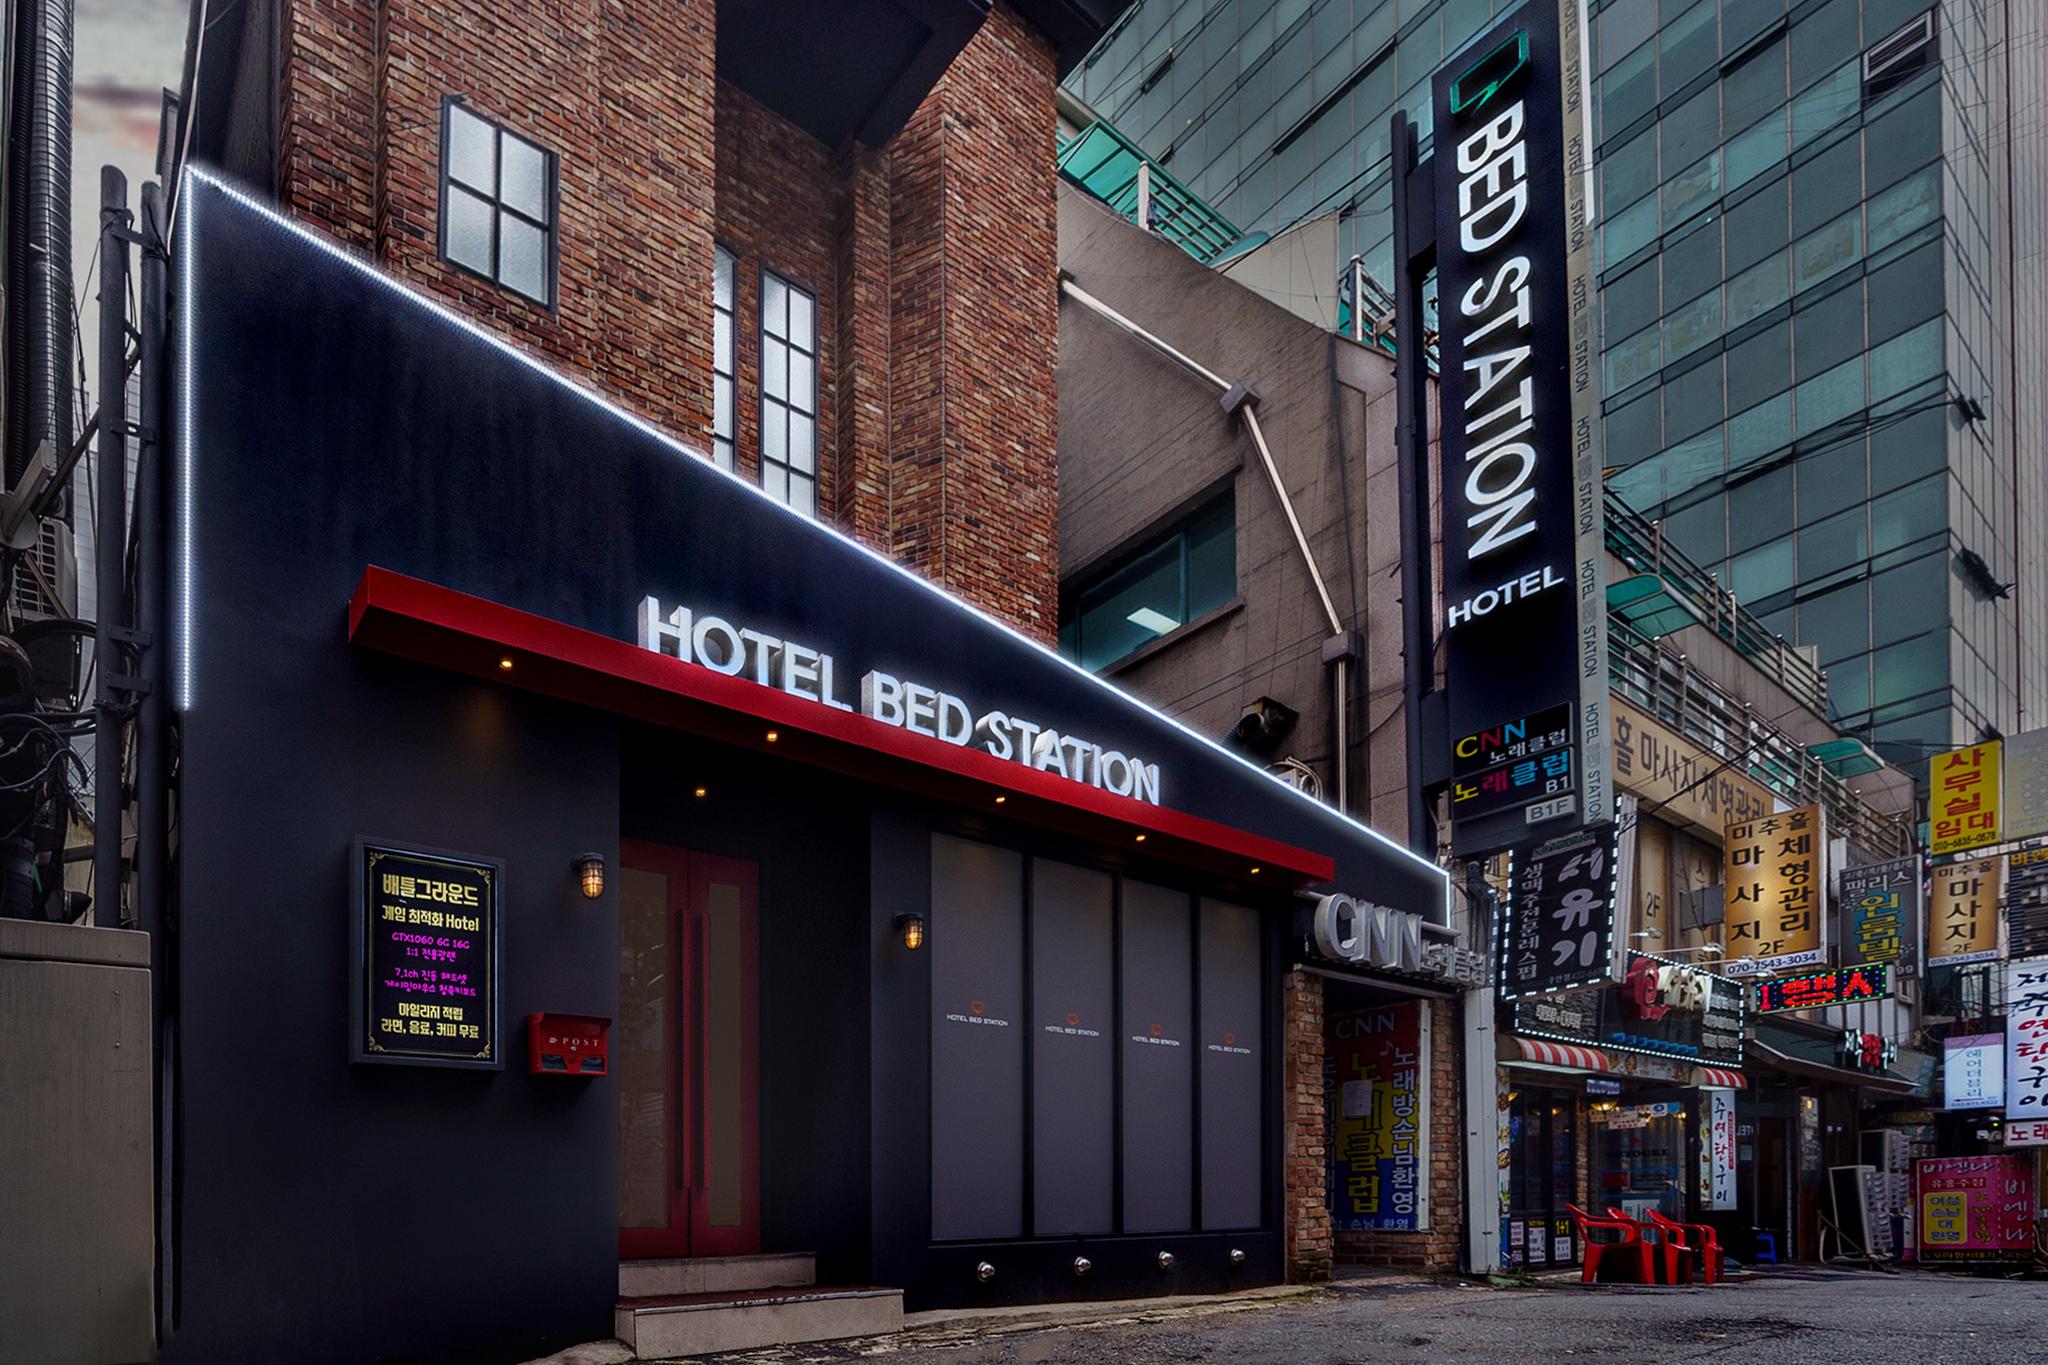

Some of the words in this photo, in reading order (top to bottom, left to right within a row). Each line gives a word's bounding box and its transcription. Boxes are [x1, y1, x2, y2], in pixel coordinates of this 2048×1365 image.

[1567, 60, 1581, 114] STATION
[1568, 133, 1582, 176] HOTEL
[1456, 99, 1528, 253] BED
[1570, 199, 1585, 255] STATION
[1572, 274, 1586, 318] HOTEL
[1574, 340, 1589, 394] STATION
[1460, 255, 1538, 560] STATION
[1576, 415, 1591, 458] HOTEL
[1579, 481, 1594, 536] STATION
[1447, 565, 1566, 629] HOTEL
[1581, 558, 1595, 600] HOTEL
[1583, 624, 1598, 678] STATION
[637, 595, 853, 712] HOTEL
[861, 669, 973, 747] BED
[973, 709, 1160, 806] STATION
[1456, 718, 1526, 759] CNN
[1585, 702, 1600, 744] HOTEL
[1488, 727, 1567, 766] 노래클럽
[1640, 731, 1697, 803] 마사지
[1453, 750, 1569, 803] 노래클럽
[1545, 775, 1569, 794] B1
[1587, 769, 1602, 823] STATION
[1943, 748, 1986, 817] 사무실
[1530, 800, 1568, 820] B1F
[1732, 811, 1810, 841] 미추홀
[1935, 810, 1994, 839] 임대
[382, 873, 479, 907] 배틀그라운드
[1730, 844, 1765, 942] 마사지
[1776, 833, 1815, 933] 체형관리
[1844, 871, 1914, 898] 팰리스
[381, 904, 407, 922] 게임
[408, 908, 444, 928] 최적화
[445, 912, 480, 932] Hotel
[1552, 847, 1605, 967] 서유기
[1856, 891, 1905, 962] 원룸텔
[1944, 878, 1985, 941] 마사지
[391, 931, 434, 946] GTX1060
[436, 937, 450, 947] 6G
[452, 939, 470, 950] 16G
[1314, 893, 1424, 973] CNN
[1757, 939, 1785, 957] 2F
[1953, 942, 1973, 954] 2F
[394, 967, 420, 979] 7.1ch
[1726, 951, 1817, 975] 070-7543-3034
[381, 1017, 407, 1034] 라면,
[408, 1020, 434, 1036] 음료,
[436, 1022, 457, 1037] 커피
[458, 1024, 480, 1039] 무료
[398, 1002, 441, 1020] 마일리지
[442, 1005, 464, 1021] 적립
[946, 1013, 969, 1023] HOTEL
[983, 1017, 1009, 1027] STATION
[1045, 1025, 1064, 1034] HOTEL
[1077, 1029, 1100, 1037] STATION
[1336, 1012, 1396, 1039] CNN
[562, 1037, 600, 1047] POST
[1132, 1035, 1149, 1044] HOTEL
[1161, 1038, 1180, 1047] STATION
[1208, 1044, 1224, 1052] HOTEL
